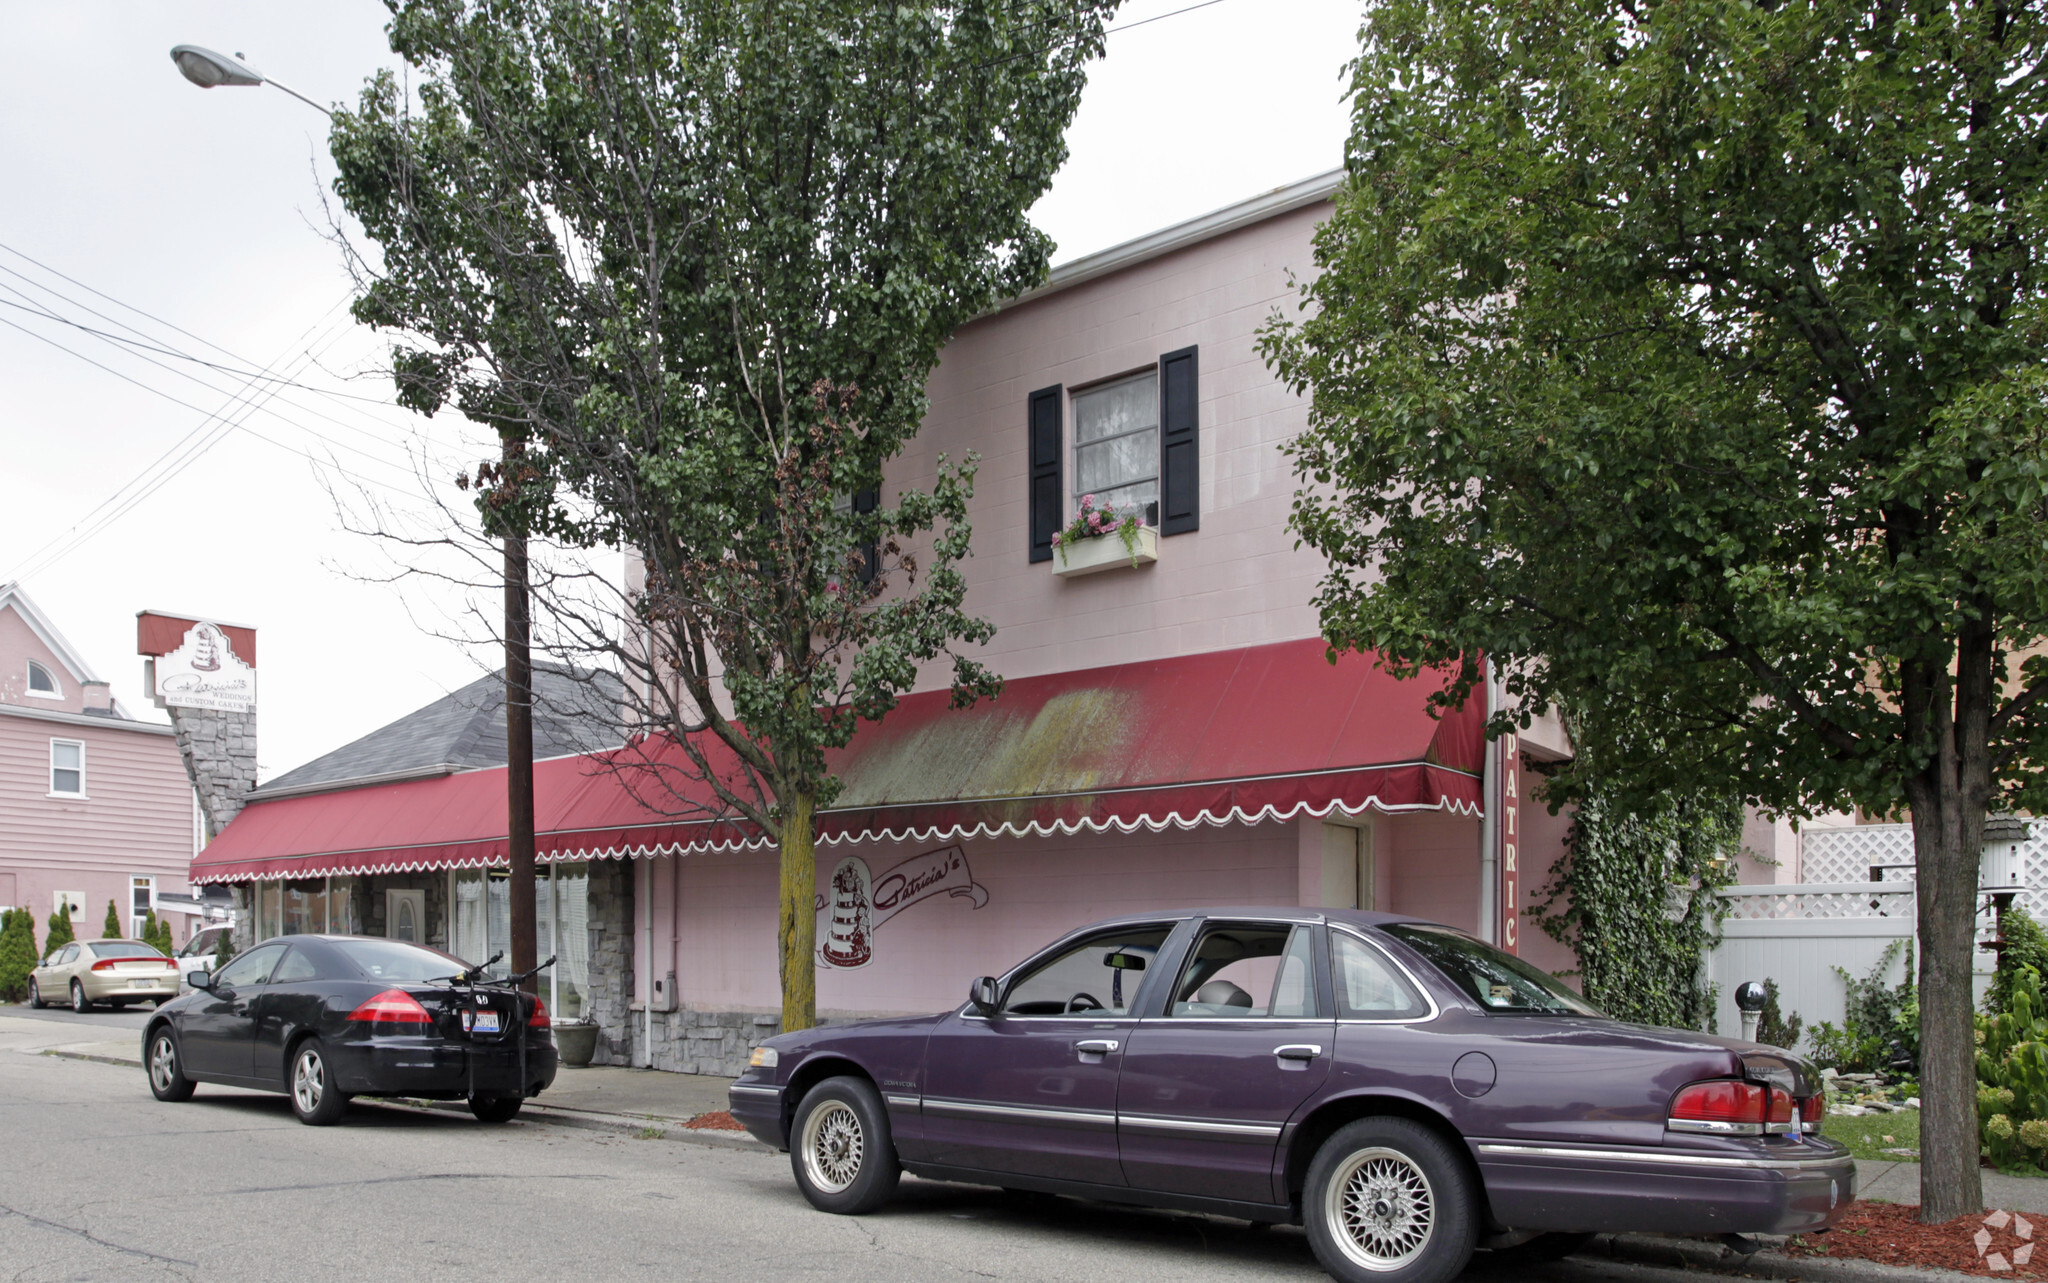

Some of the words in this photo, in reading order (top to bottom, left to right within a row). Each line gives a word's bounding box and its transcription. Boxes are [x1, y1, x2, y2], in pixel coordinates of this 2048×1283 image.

[212, 691, 252, 701] WEDDINGS
[185, 697, 215, 706] CUSTOM
[218, 701, 245, 709] CAKES
[873, 851, 960, 910] Patricia's
